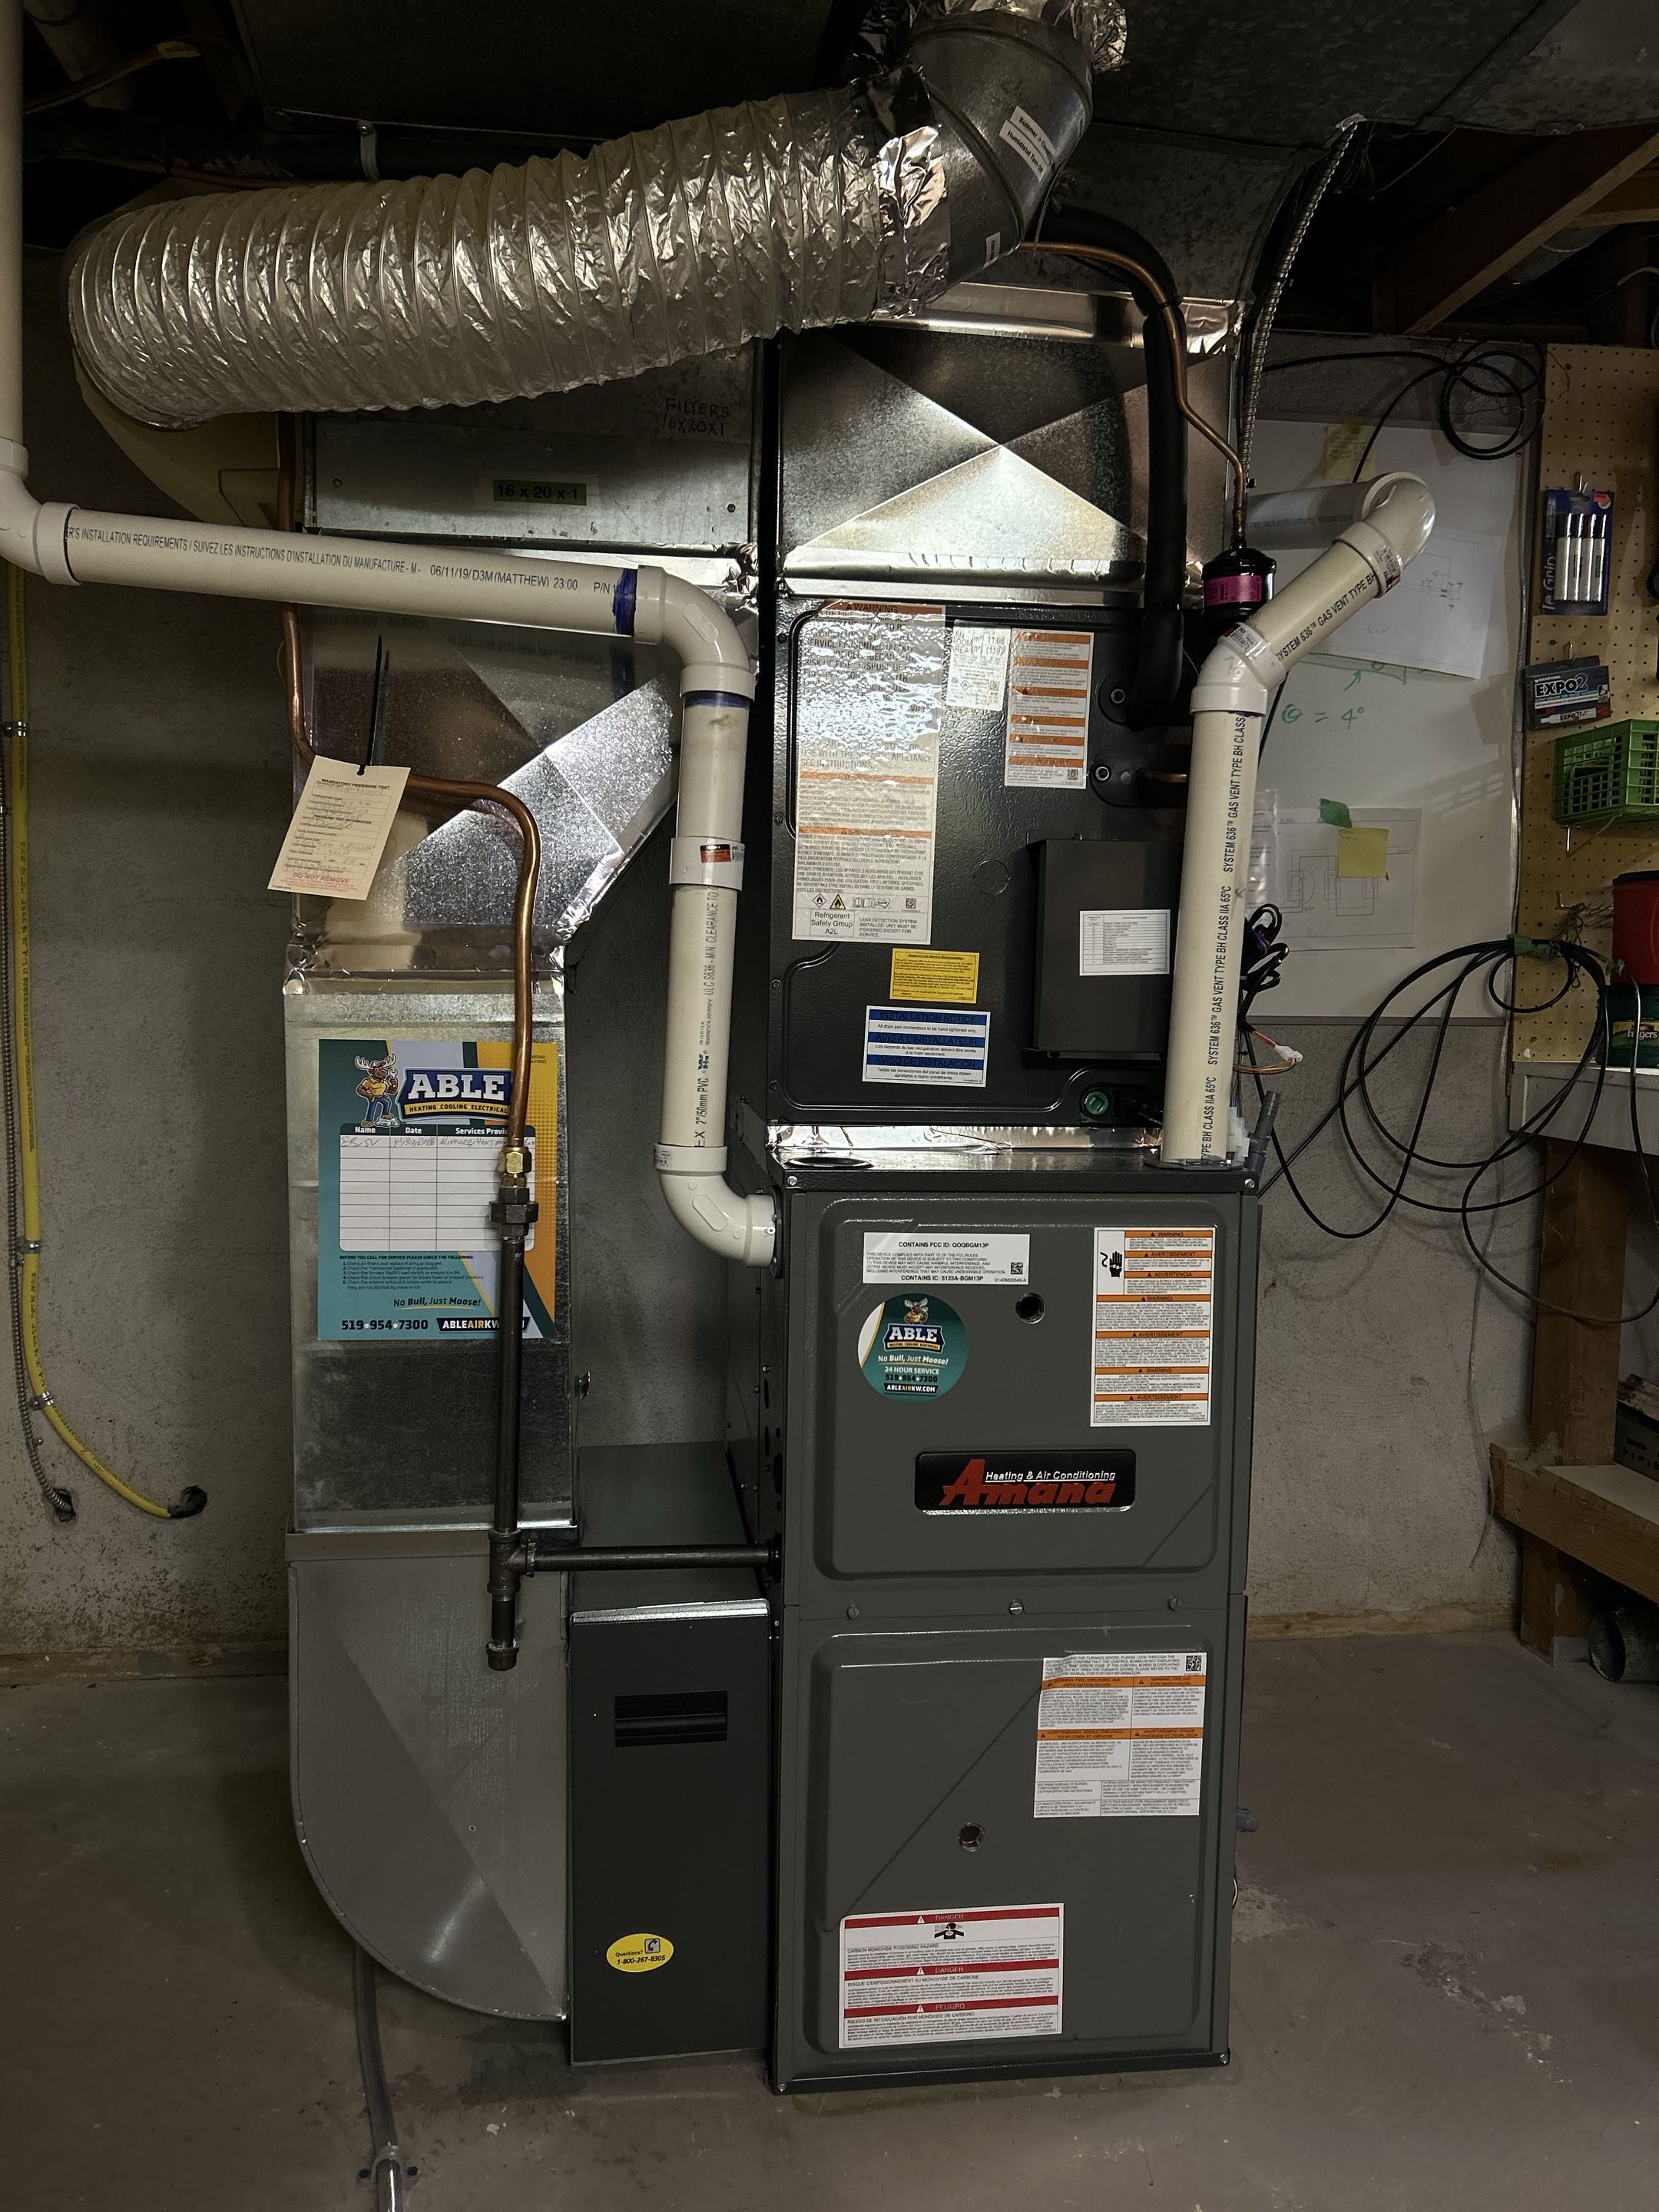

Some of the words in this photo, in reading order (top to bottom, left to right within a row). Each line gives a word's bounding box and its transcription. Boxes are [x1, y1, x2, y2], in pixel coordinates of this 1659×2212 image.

[666, 398, 729, 418] FILTERS
[498, 485, 514, 497] 16
[520, 488, 528, 498] x
[533, 486, 551, 498] 20
[556, 490, 565, 499] x
[571, 488, 578, 500] 1
[82, 529, 131, 545] INSTALLATION
[133, 535, 187, 551] REQUIREMENTS
[194, 540, 218, 555] SUIVEZ
[220, 543, 233, 556] LES
[235, 546, 285, 561] INSTRUCTIONS
[287, 550, 340, 567] D'INSTALLATION
[343, 555, 352, 568] DU
[354, 557, 404, 572] MANUFACTURE
[554, 578, 578, 591] 23:00
[594, 582, 610, 594] P/N
[1318, 610, 1332, 626] GAS
[1332, 594, 1349, 613] VENT
[1349, 580, 1367, 599] TYPE
[1366, 573, 1376, 585] BH
[854, 604, 898, 612] WARNING
[1234, 717, 1246, 743] CLASS
[1233, 745, 1243, 756] BH
[1231, 757, 1242, 778] TYPE
[1230, 780, 1241, 800] VENT
[1228, 802, 1238, 817] GAS
[1224, 843, 1235, 873] SYSTEM
[1220, 905, 1230, 915] IIA
[706, 903, 718, 943] CLEARANCE
[1217, 916, 1228, 940] CLASS
[1217, 942, 1227, 952] BH
[704, 965, 716, 980] S636
[1215, 955, 1226, 975] TYPE
[704, 982, 714, 995] ULC
[1214, 975, 1224, 995] VENT
[1212, 995, 1222, 1012] GAS
[880, 1011, 941, 1022] INSTALLATION
[944, 1015, 976, 1023] NOTICE
[906, 1036, 977, 1045] L'INSTALLATEUR
[1208, 1036, 1219, 1065] SYSTEM
[408, 1075, 505, 1101] ABLE
[697, 1078, 709, 1092] PVC
[1205, 1094, 1214, 1104] IIA
[472, 1104, 508, 1113] ELECTRICAL
[1203, 1106, 1214, 1130] CLASS
[1203, 1132, 1211, 1141] BH
[408, 1297, 427, 1306] Bull,
[449, 1297, 481, 1306] Moose!
[442, 1320, 524, 1329] ABLEAIRKW
[889, 1326, 937, 1343] ABLE
[922, 1356, 949, 1366] Moose!
[939, 1459, 1116, 1506] Amana
[986, 1472, 1023, 1482] Heating
[1026, 1471, 1034, 1480] &
[1036, 1471, 1051, 1480] Air
[1053, 1471, 1115, 1481] Conditioning
[618, 1955, 666, 1965] 1-800-267-8305
